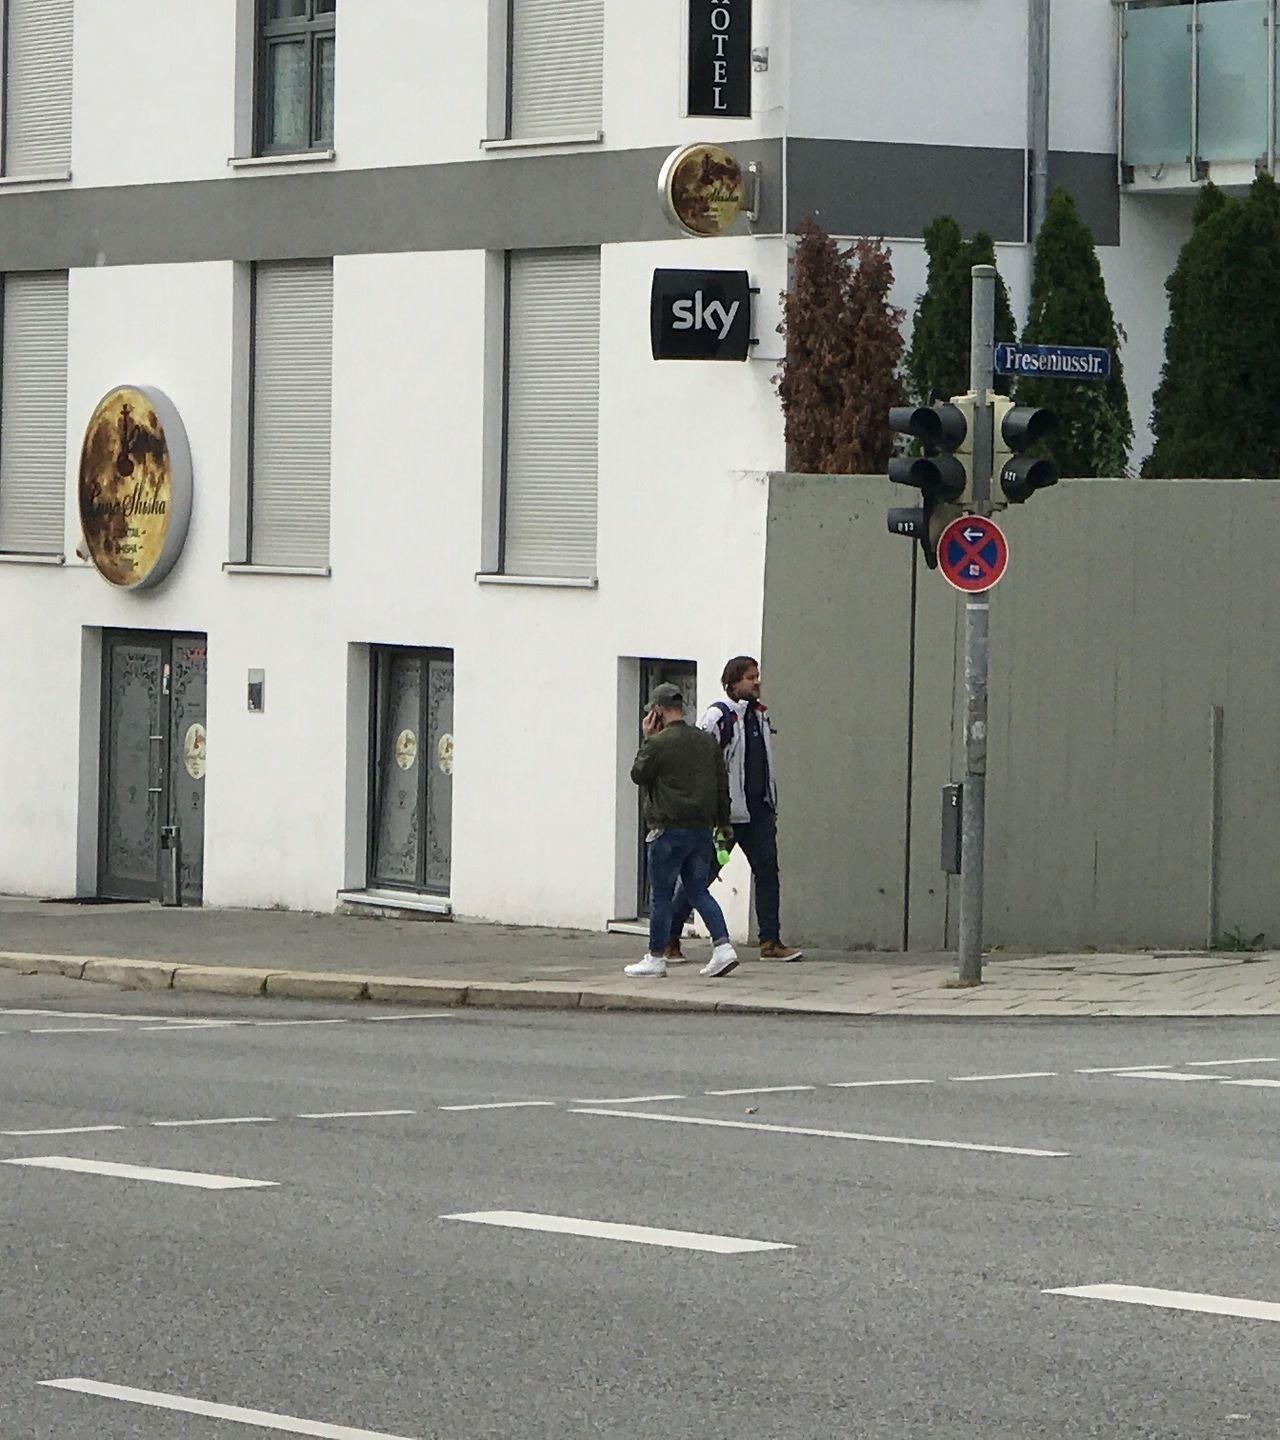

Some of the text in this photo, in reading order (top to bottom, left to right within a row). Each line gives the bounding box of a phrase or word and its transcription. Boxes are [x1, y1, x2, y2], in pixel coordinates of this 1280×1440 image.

[672, 290, 740, 340] sky
[1005, 347, 1103, 374] Freseniusstr.
[122, 481, 166, 517] Shisha
